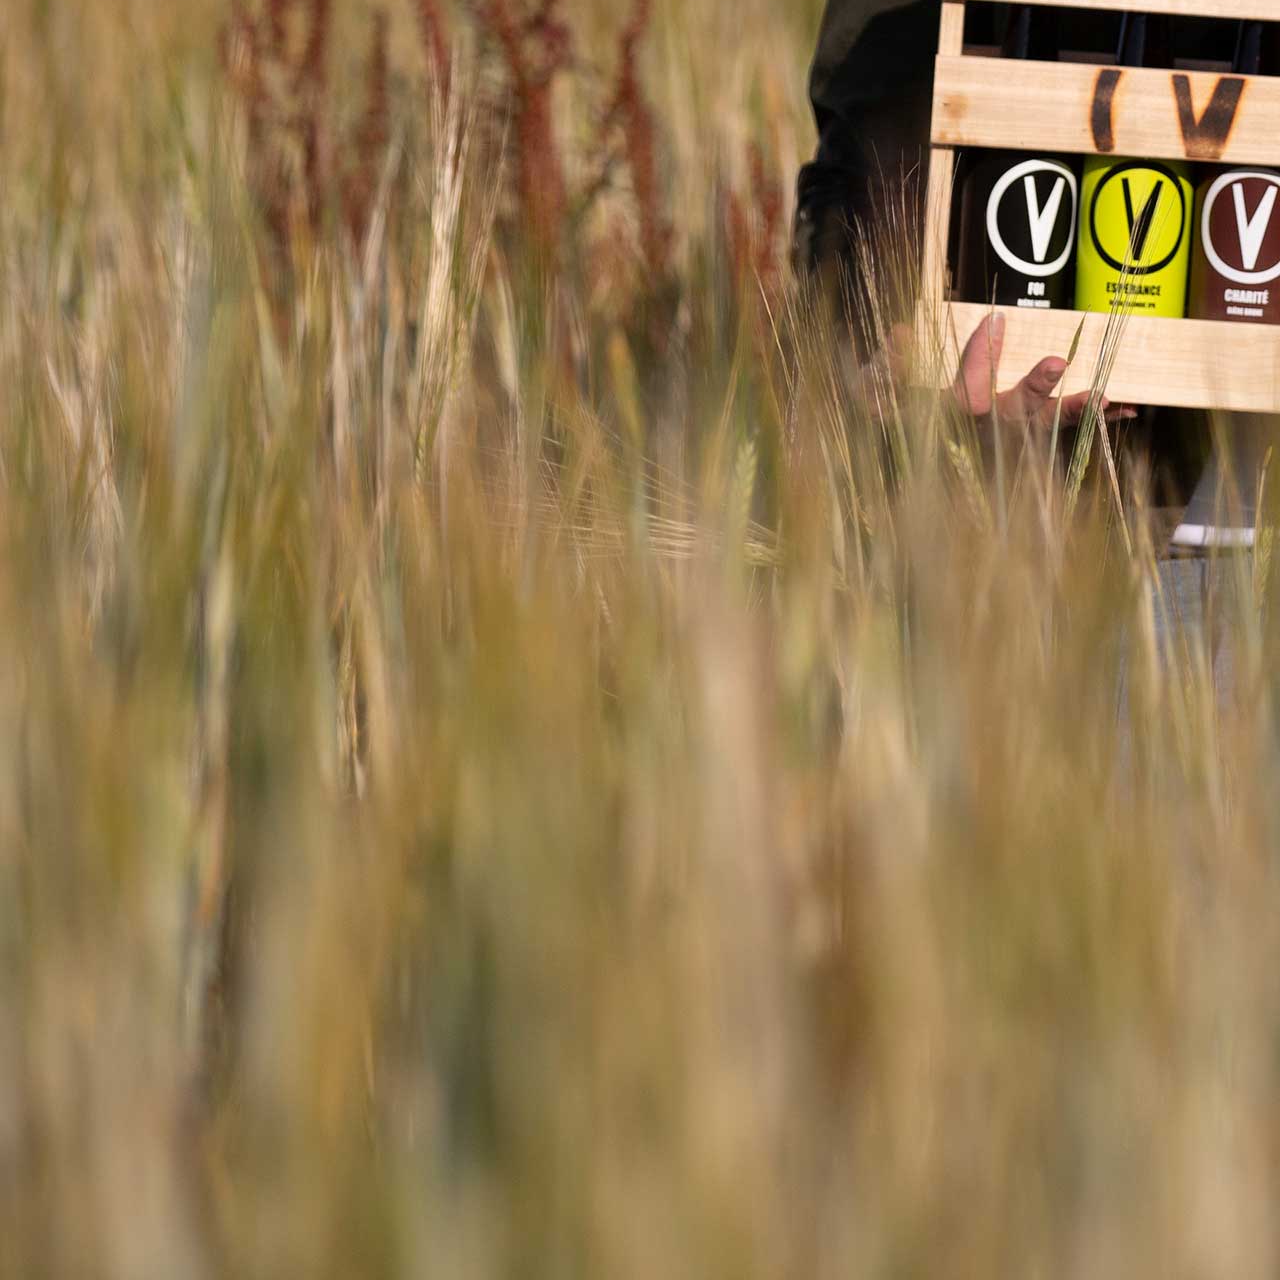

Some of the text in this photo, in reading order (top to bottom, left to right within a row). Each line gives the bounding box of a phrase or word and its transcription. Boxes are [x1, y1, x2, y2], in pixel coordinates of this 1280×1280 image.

[1023, 175, 1066, 263] V
[1121, 177, 1164, 261] V
[1231, 182, 1279, 271] V
[1027, 281, 1046, 297] FOI
[1224, 288, 1270, 305] CHARITÉ
